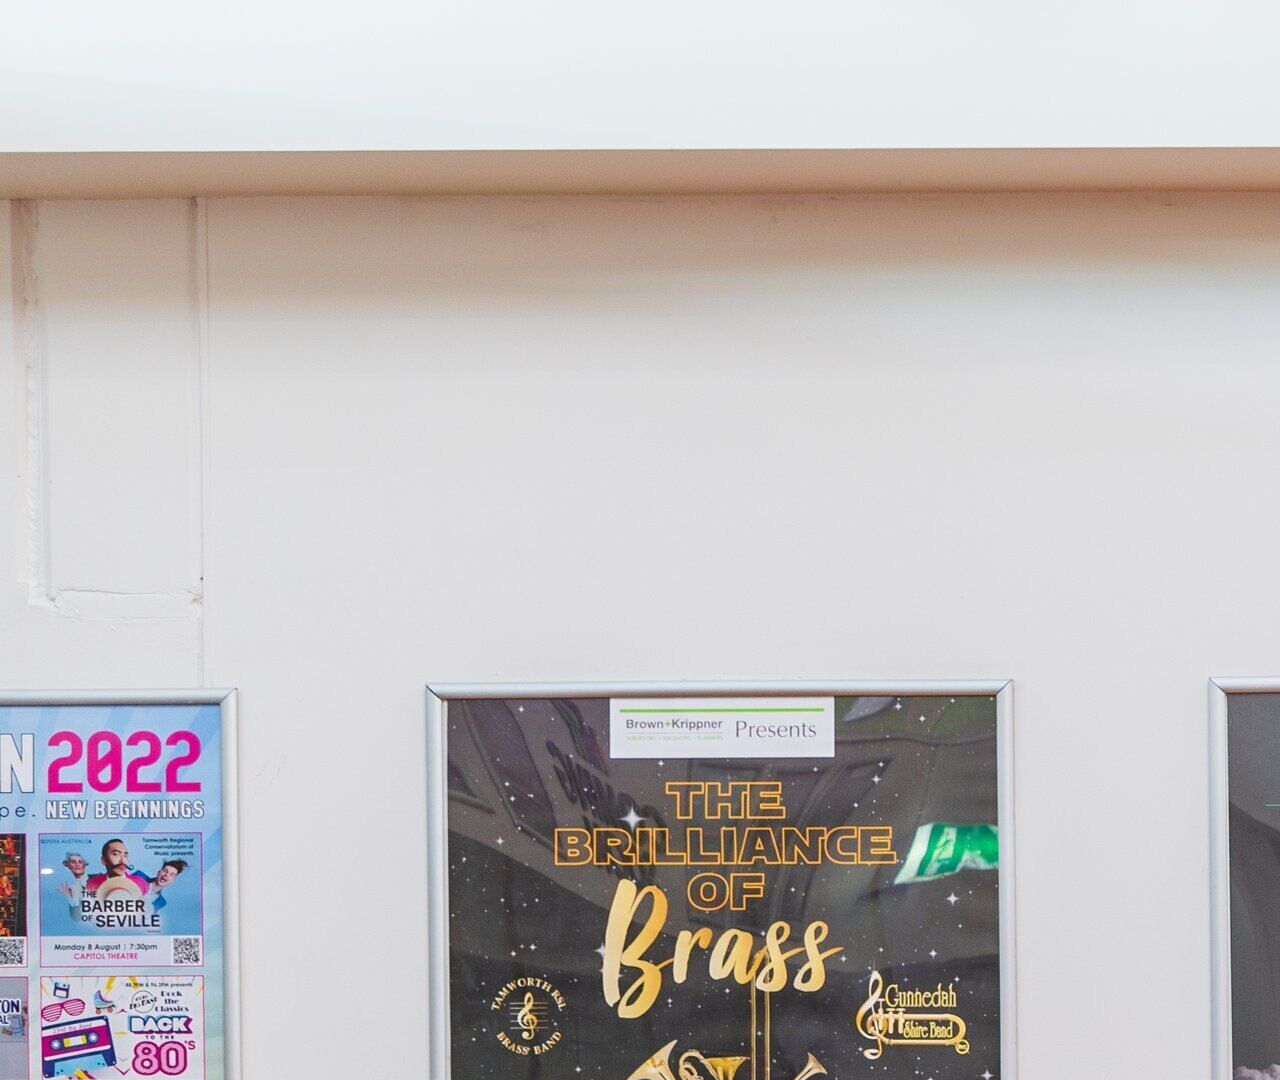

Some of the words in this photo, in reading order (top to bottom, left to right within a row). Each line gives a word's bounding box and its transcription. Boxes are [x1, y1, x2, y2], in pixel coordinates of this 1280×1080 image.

[735, 720, 817, 738] Presents
[47, 730, 201, 793] 2022
[46, 800, 88, 819] NEW
[94, 800, 205, 819] BEGINNINGS
[665, 781, 786, 820] THE
[554, 826, 897, 867] BRILLIANCE
[81, 890, 97, 898] THE
[687, 873, 765, 911] OF
[81, 900, 145, 912] BARBER
[96, 915, 160, 928] SEVILLE
[54, 943, 85, 951] Monday
[95, 944, 121, 952] August
[129, 943, 158, 951] 7:30pm
[108, 952, 139, 960] THEATRE
[602, 878, 845, 1019] Brass
[491, 977, 553, 1011] TAMWORTH
[551, 989, 567, 1012] RSL
[885, 983, 957, 1008] Gunnedah
[128, 1015, 192, 1034] BACK
[903, 1021, 929, 1039] Shire
[930, 1021, 953, 1039] Band
[496, 1031, 530, 1055] BRASS
[533, 1031, 562, 1055] BAND
